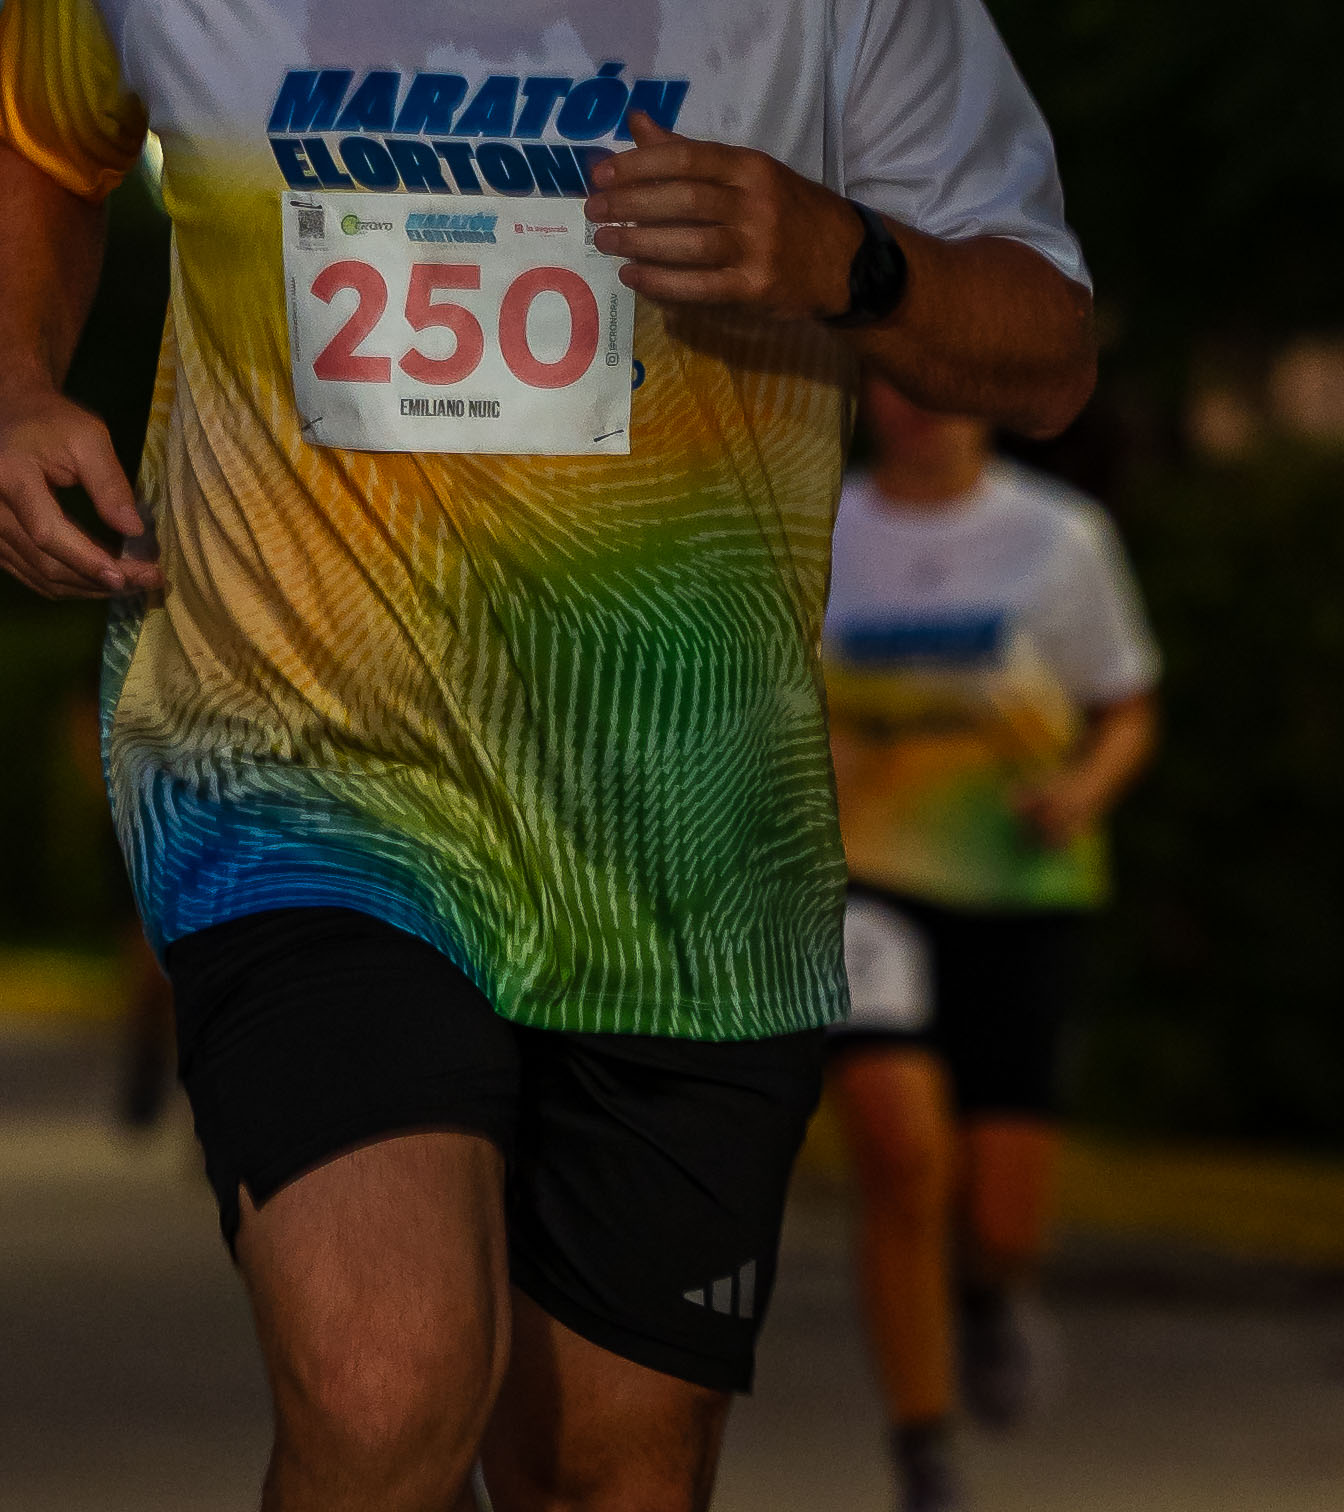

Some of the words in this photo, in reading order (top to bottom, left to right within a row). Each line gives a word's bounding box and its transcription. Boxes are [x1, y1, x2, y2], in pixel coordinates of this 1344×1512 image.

[267, 63, 690, 141] MARATÓN
[310, 260, 600, 389] 250
[400, 399, 465, 417] EMILIANO
[468, 400, 501, 418] NUIC
